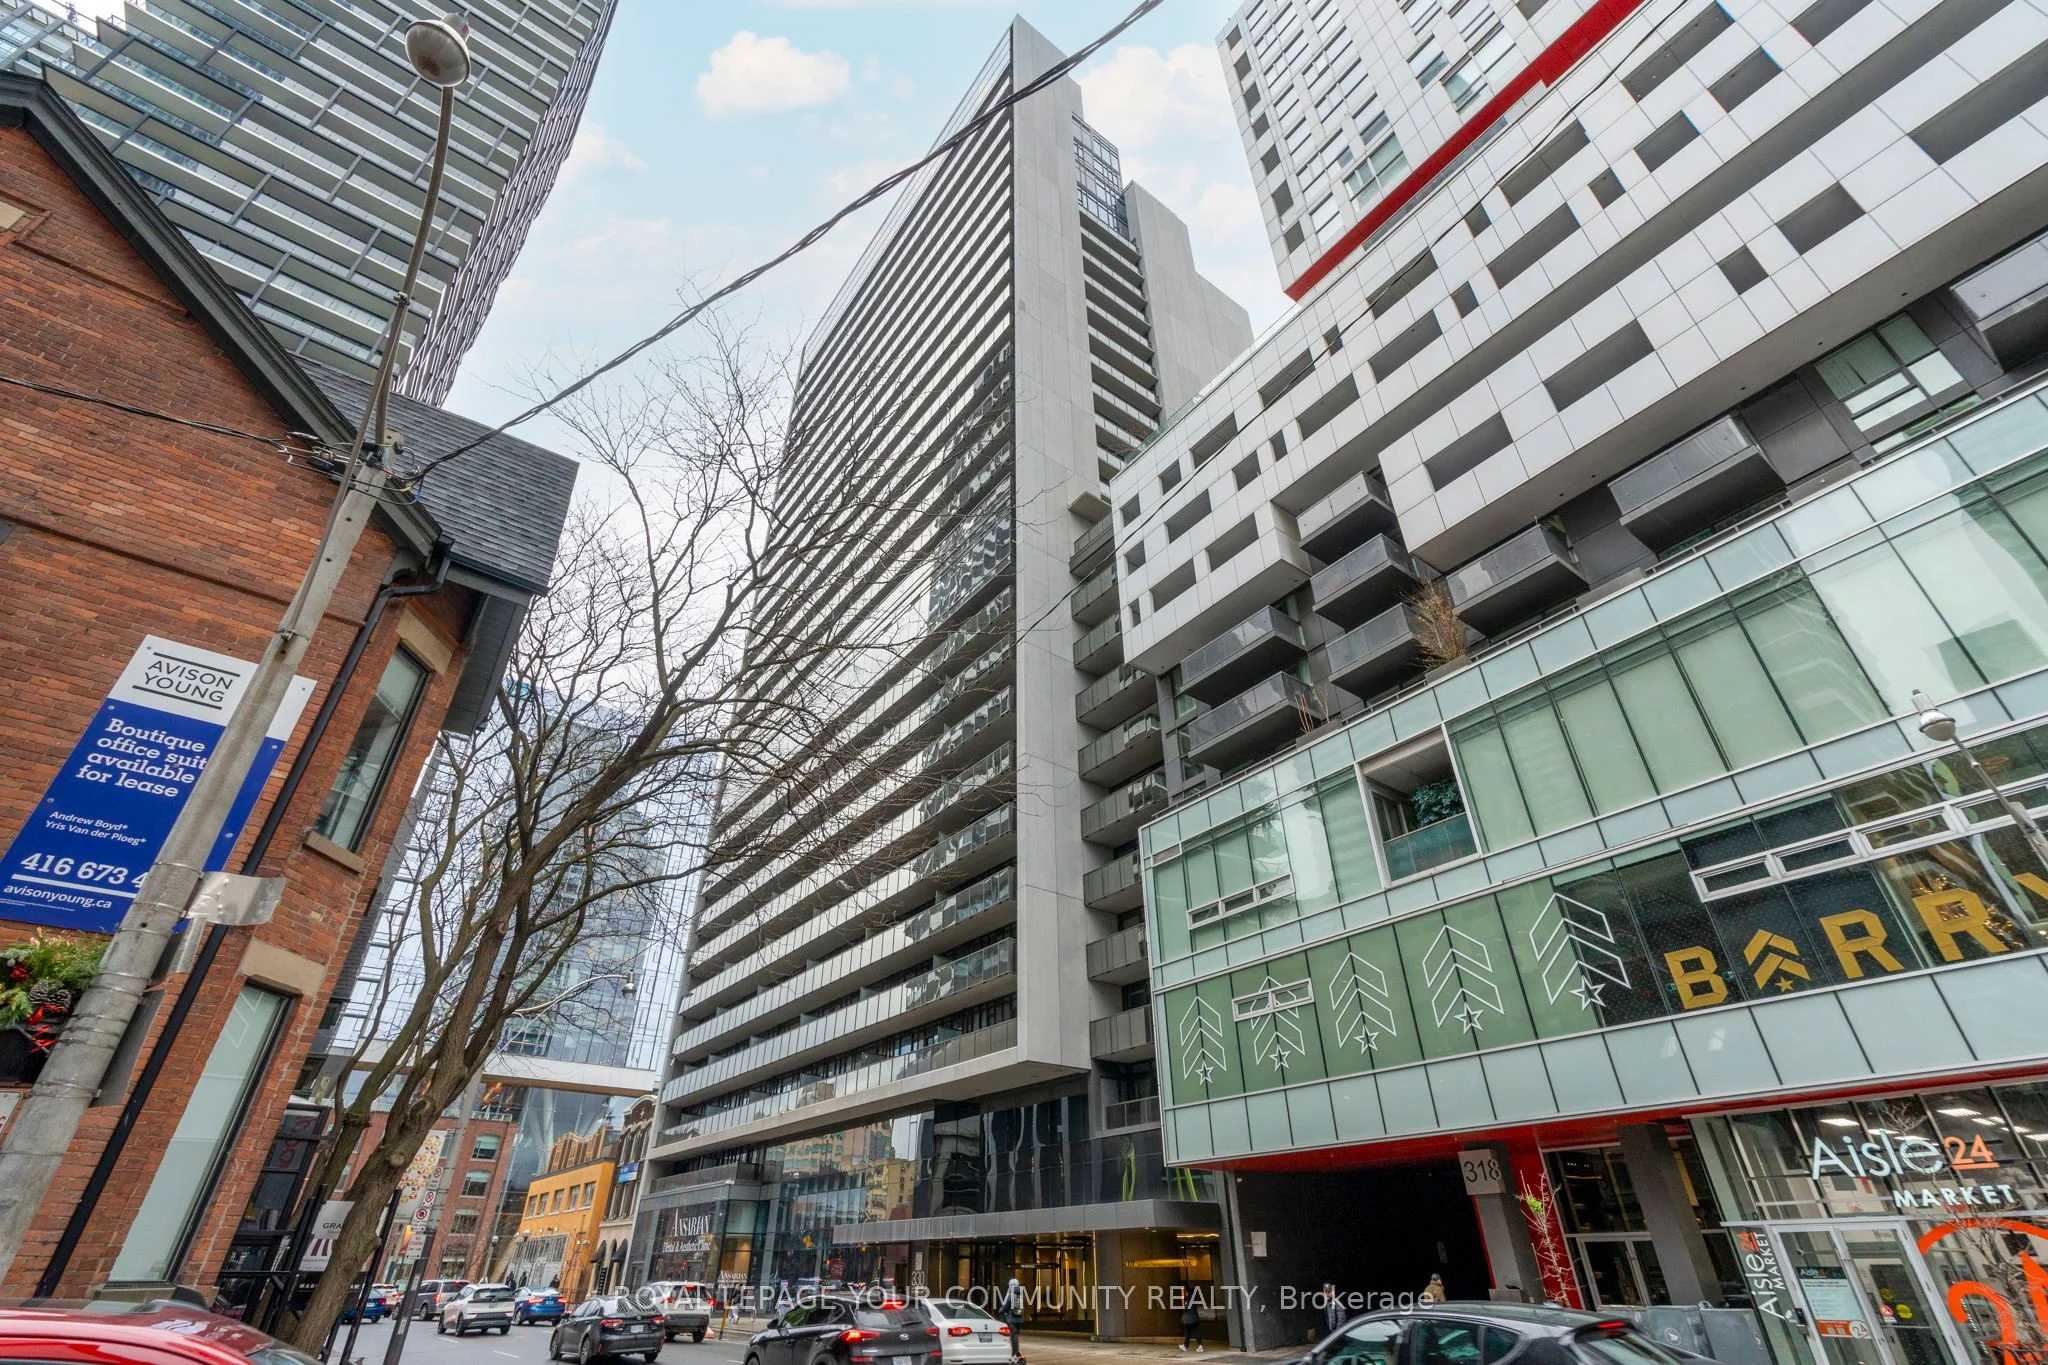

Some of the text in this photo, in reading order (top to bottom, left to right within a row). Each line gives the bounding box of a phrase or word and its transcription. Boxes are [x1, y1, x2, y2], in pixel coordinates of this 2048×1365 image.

[143, 672, 225, 702] YOUNG
[148, 660, 233, 690] AVISON
[104, 718, 206, 752] Boutique
[87, 752, 195, 784] available
[97, 736, 208, 770] office suit
[75, 764, 179, 797] for lease
[45, 820, 67, 831] Yris
[68, 824, 89, 835] Van
[90, 829, 110, 839] der
[49, 811, 93, 826] Andrew
[20, 852, 149, 888] 416 673 4
[3, 885, 112, 909] avisonyoung.ca
[1463, 1158, 1502, 1183] 318
[1892, 1184, 2016, 1208] MARKET
[1754, 1231, 1786, 1290] MARKET
[911, 1270, 925, 1286] 330
